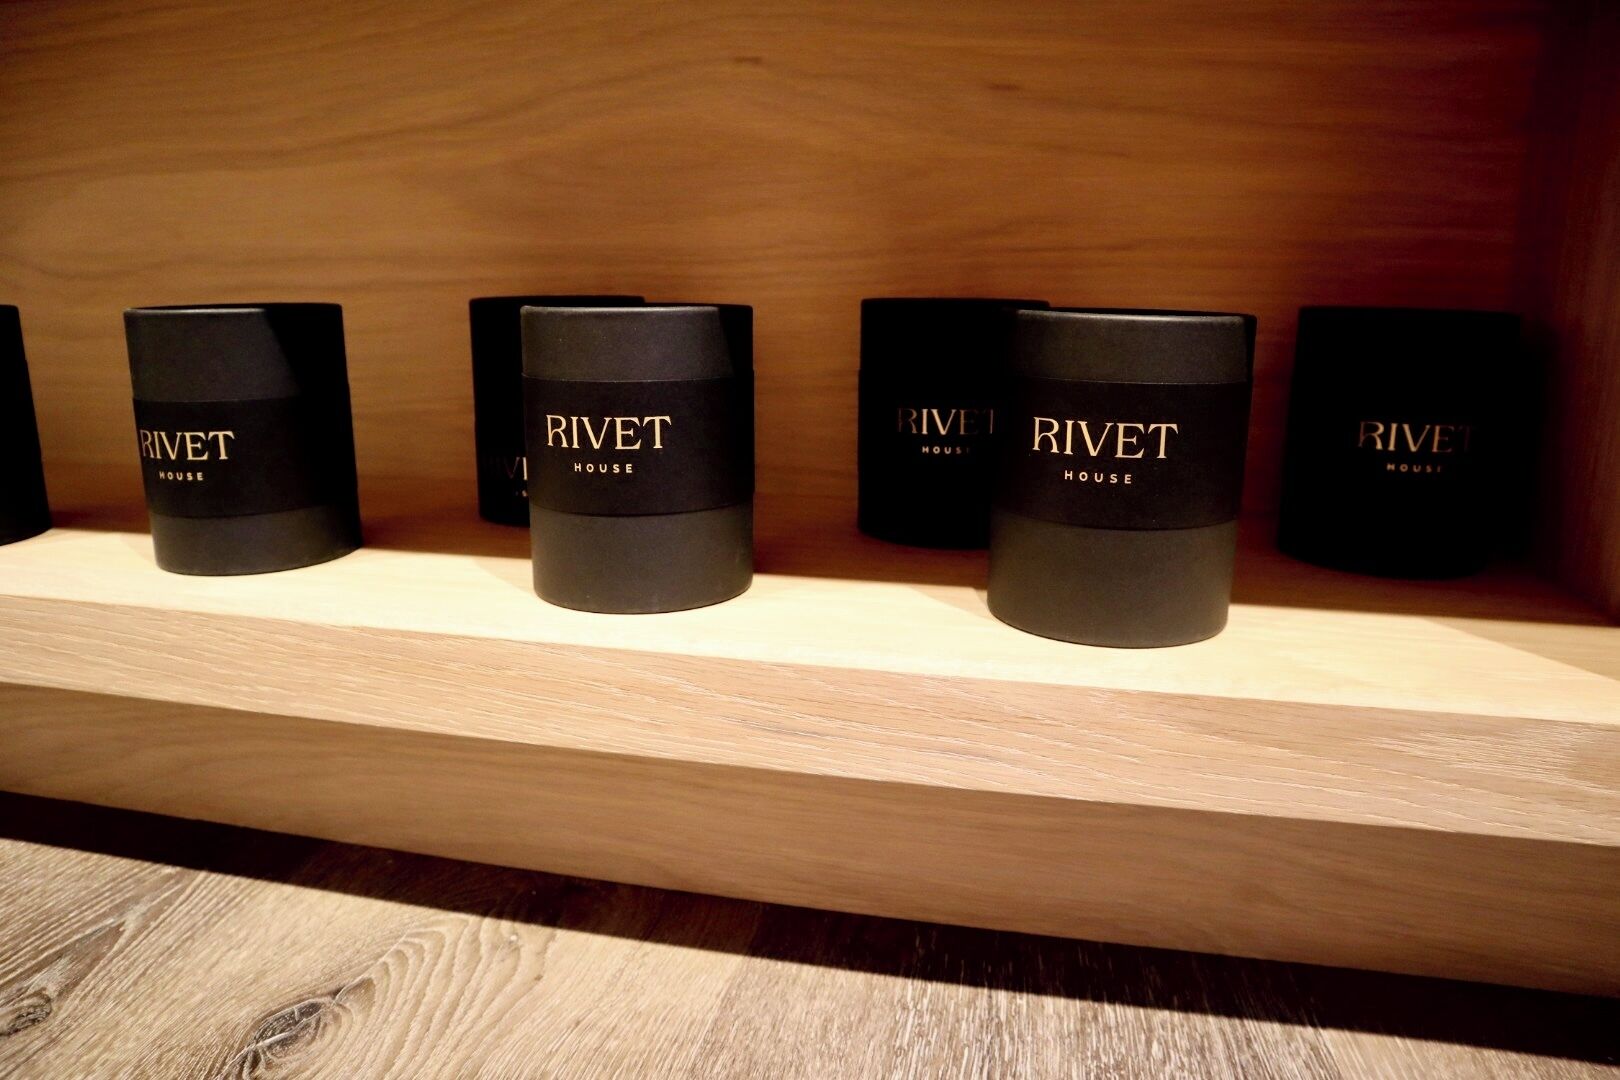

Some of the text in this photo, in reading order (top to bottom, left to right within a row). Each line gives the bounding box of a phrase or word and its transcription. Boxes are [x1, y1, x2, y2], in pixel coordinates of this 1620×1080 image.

[546, 415, 672, 450] RIVET
[1032, 417, 1179, 459] RIVET
[139, 429, 235, 461] RIVET
[159, 471, 204, 481] HOUSE
[574, 463, 633, 474] HOUSE
[1064, 469, 1132, 485] HOUSE
